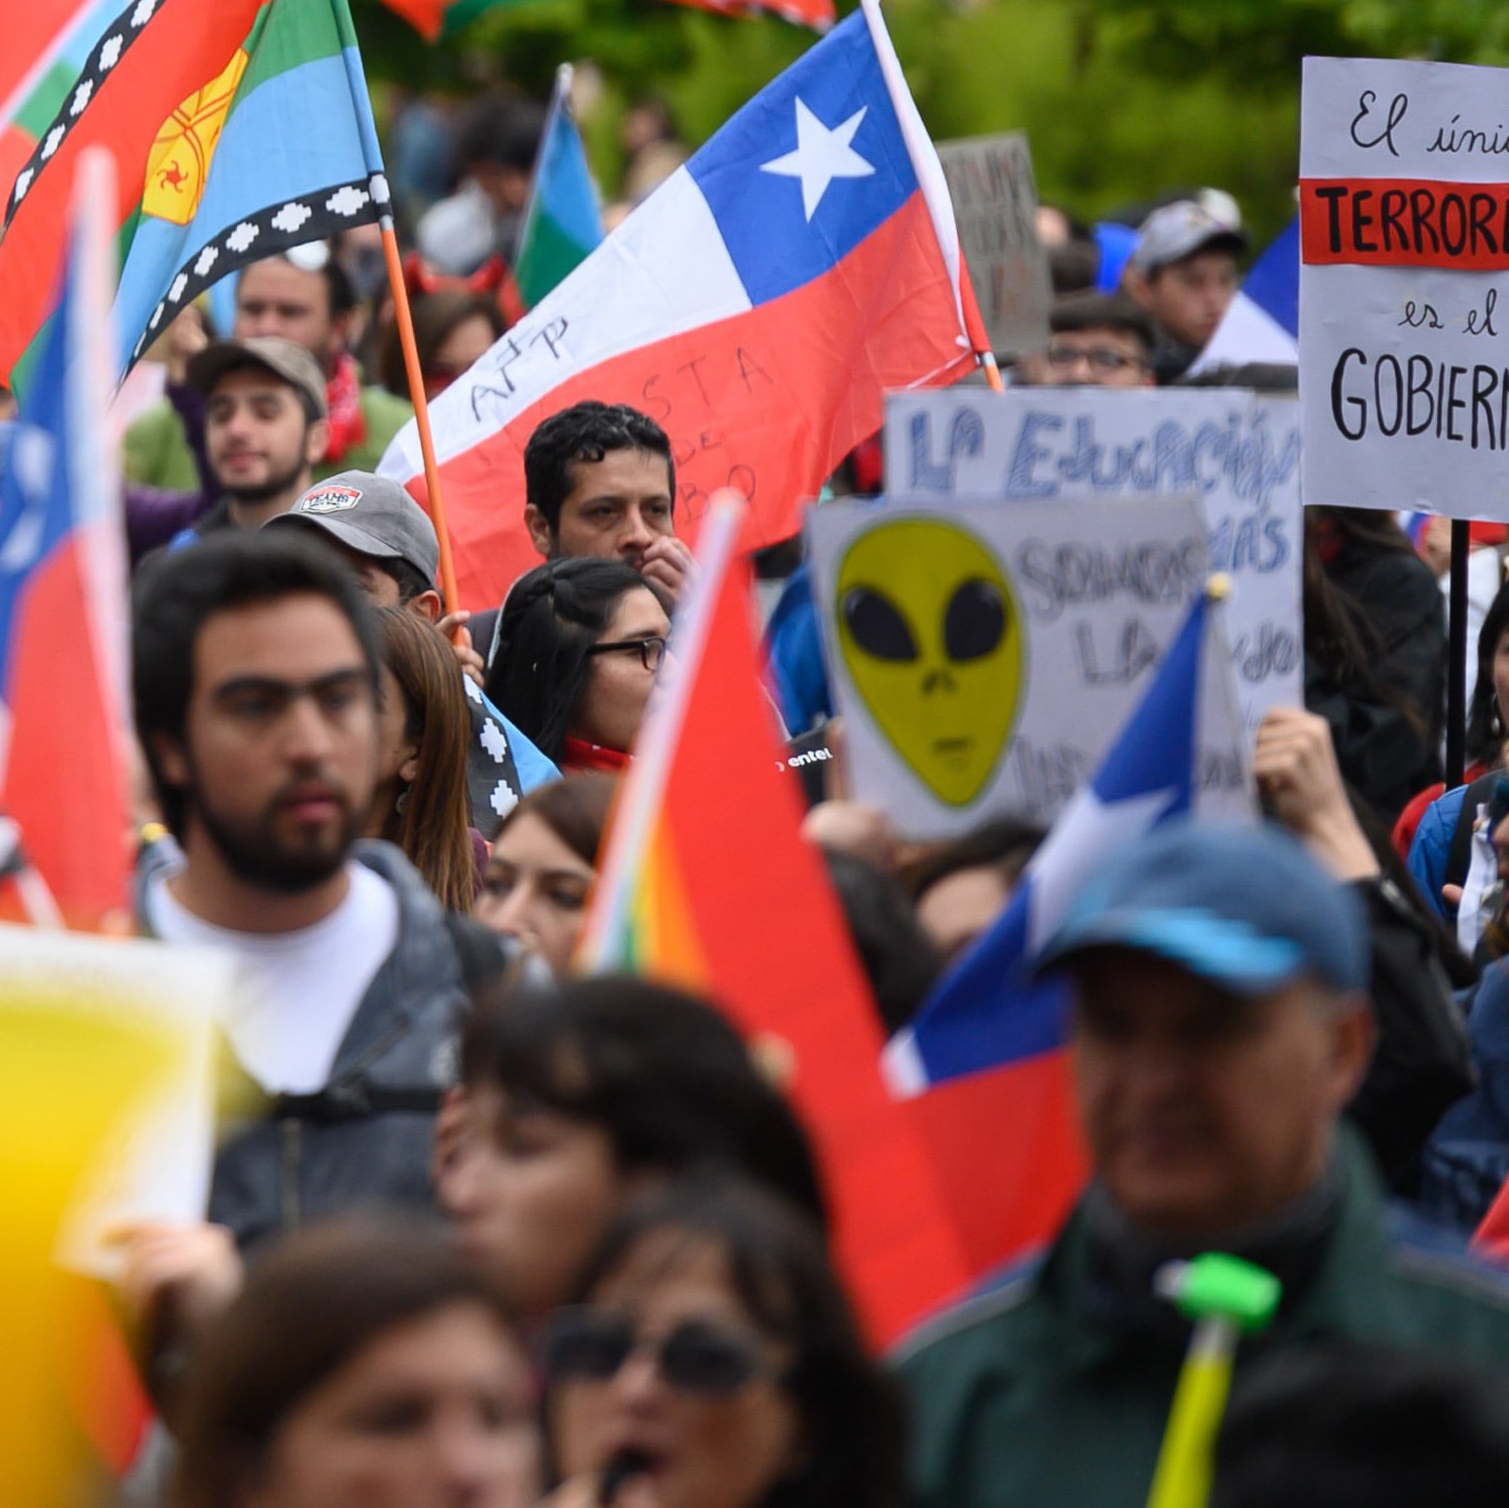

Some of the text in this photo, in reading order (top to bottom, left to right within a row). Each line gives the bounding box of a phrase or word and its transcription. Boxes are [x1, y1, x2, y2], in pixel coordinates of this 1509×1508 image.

[1350, 90, 1408, 156] El
[1397, 288, 1498, 336] es el
[907, 406, 985, 494] LA
[788, 747, 833, 767] entel
